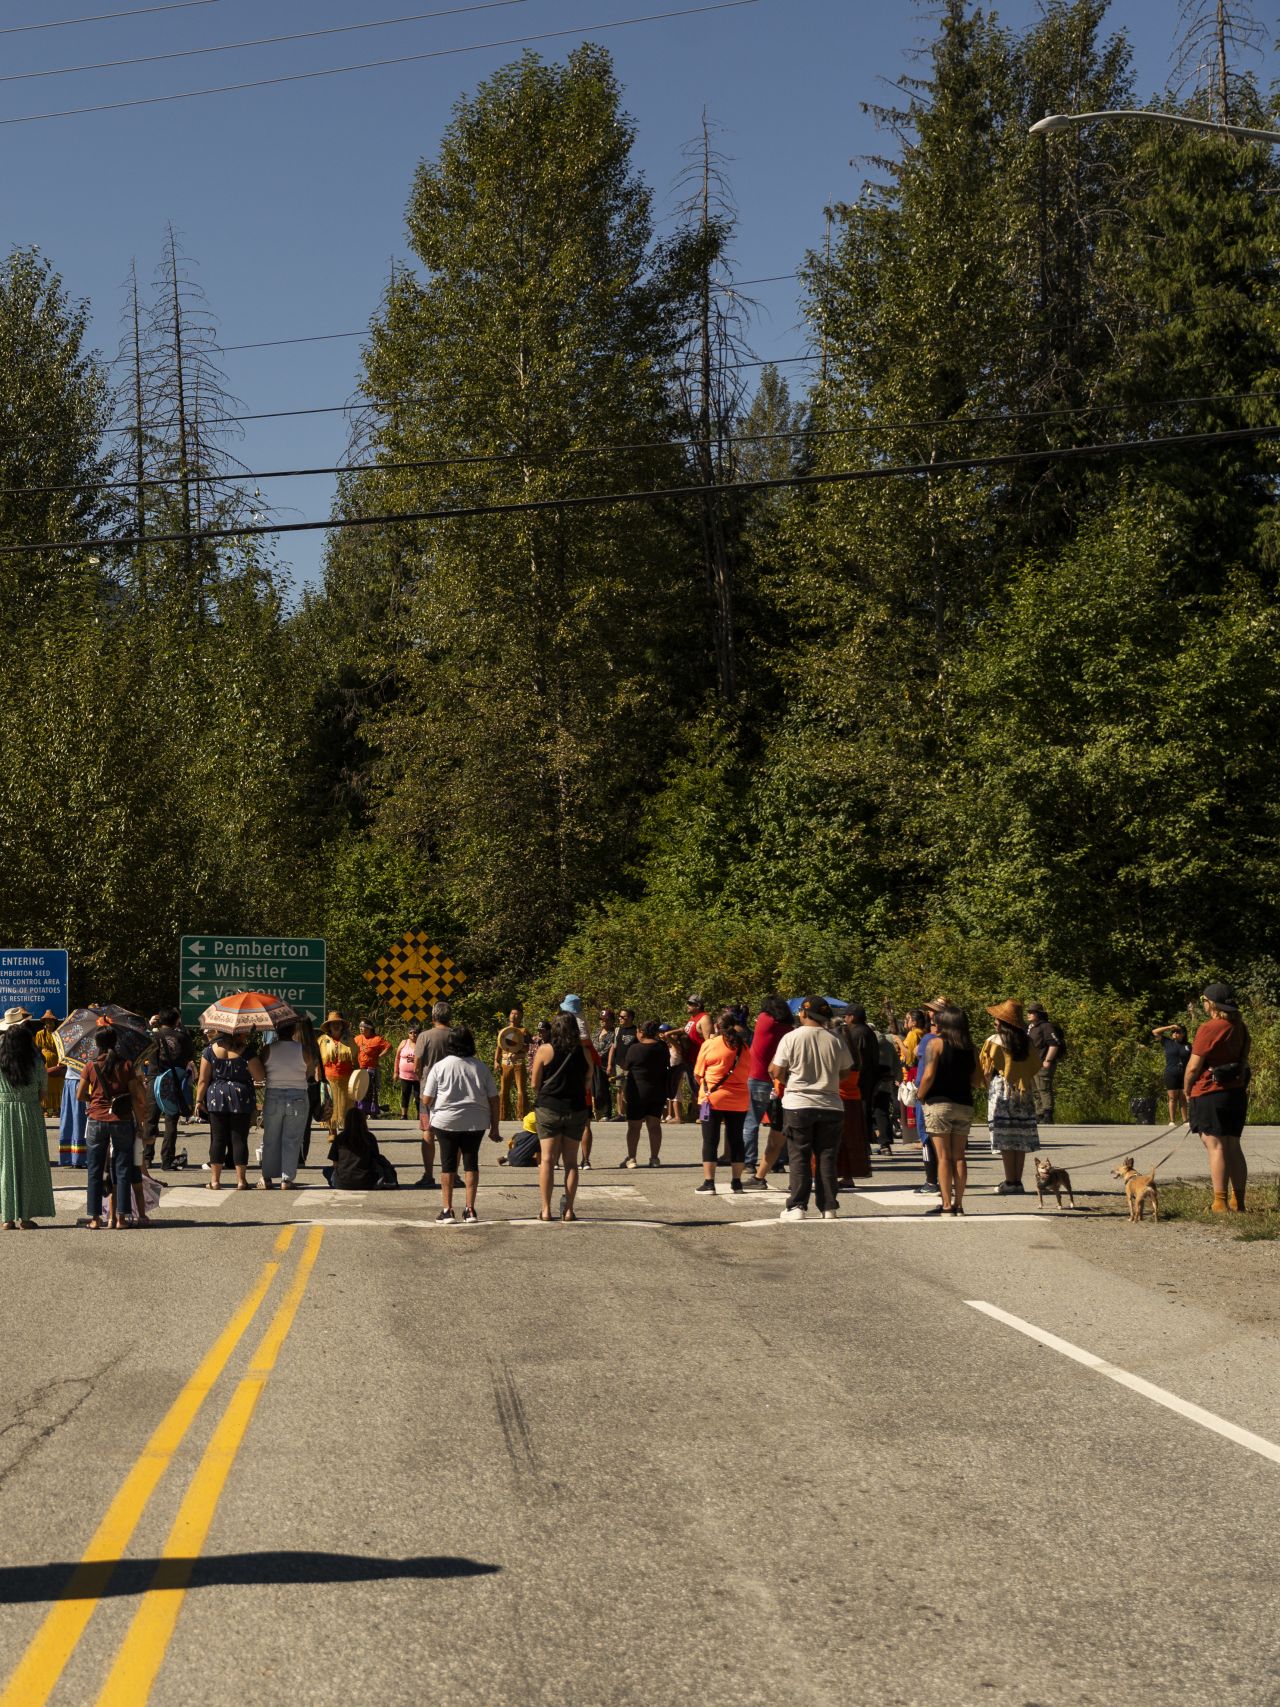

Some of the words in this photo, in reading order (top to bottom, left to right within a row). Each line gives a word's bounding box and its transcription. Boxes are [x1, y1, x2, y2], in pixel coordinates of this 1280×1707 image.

[214, 941, 309, 957] Pemberton
[2, 957, 45, 966] ENTERING
[214, 963, 287, 978] Whistler
